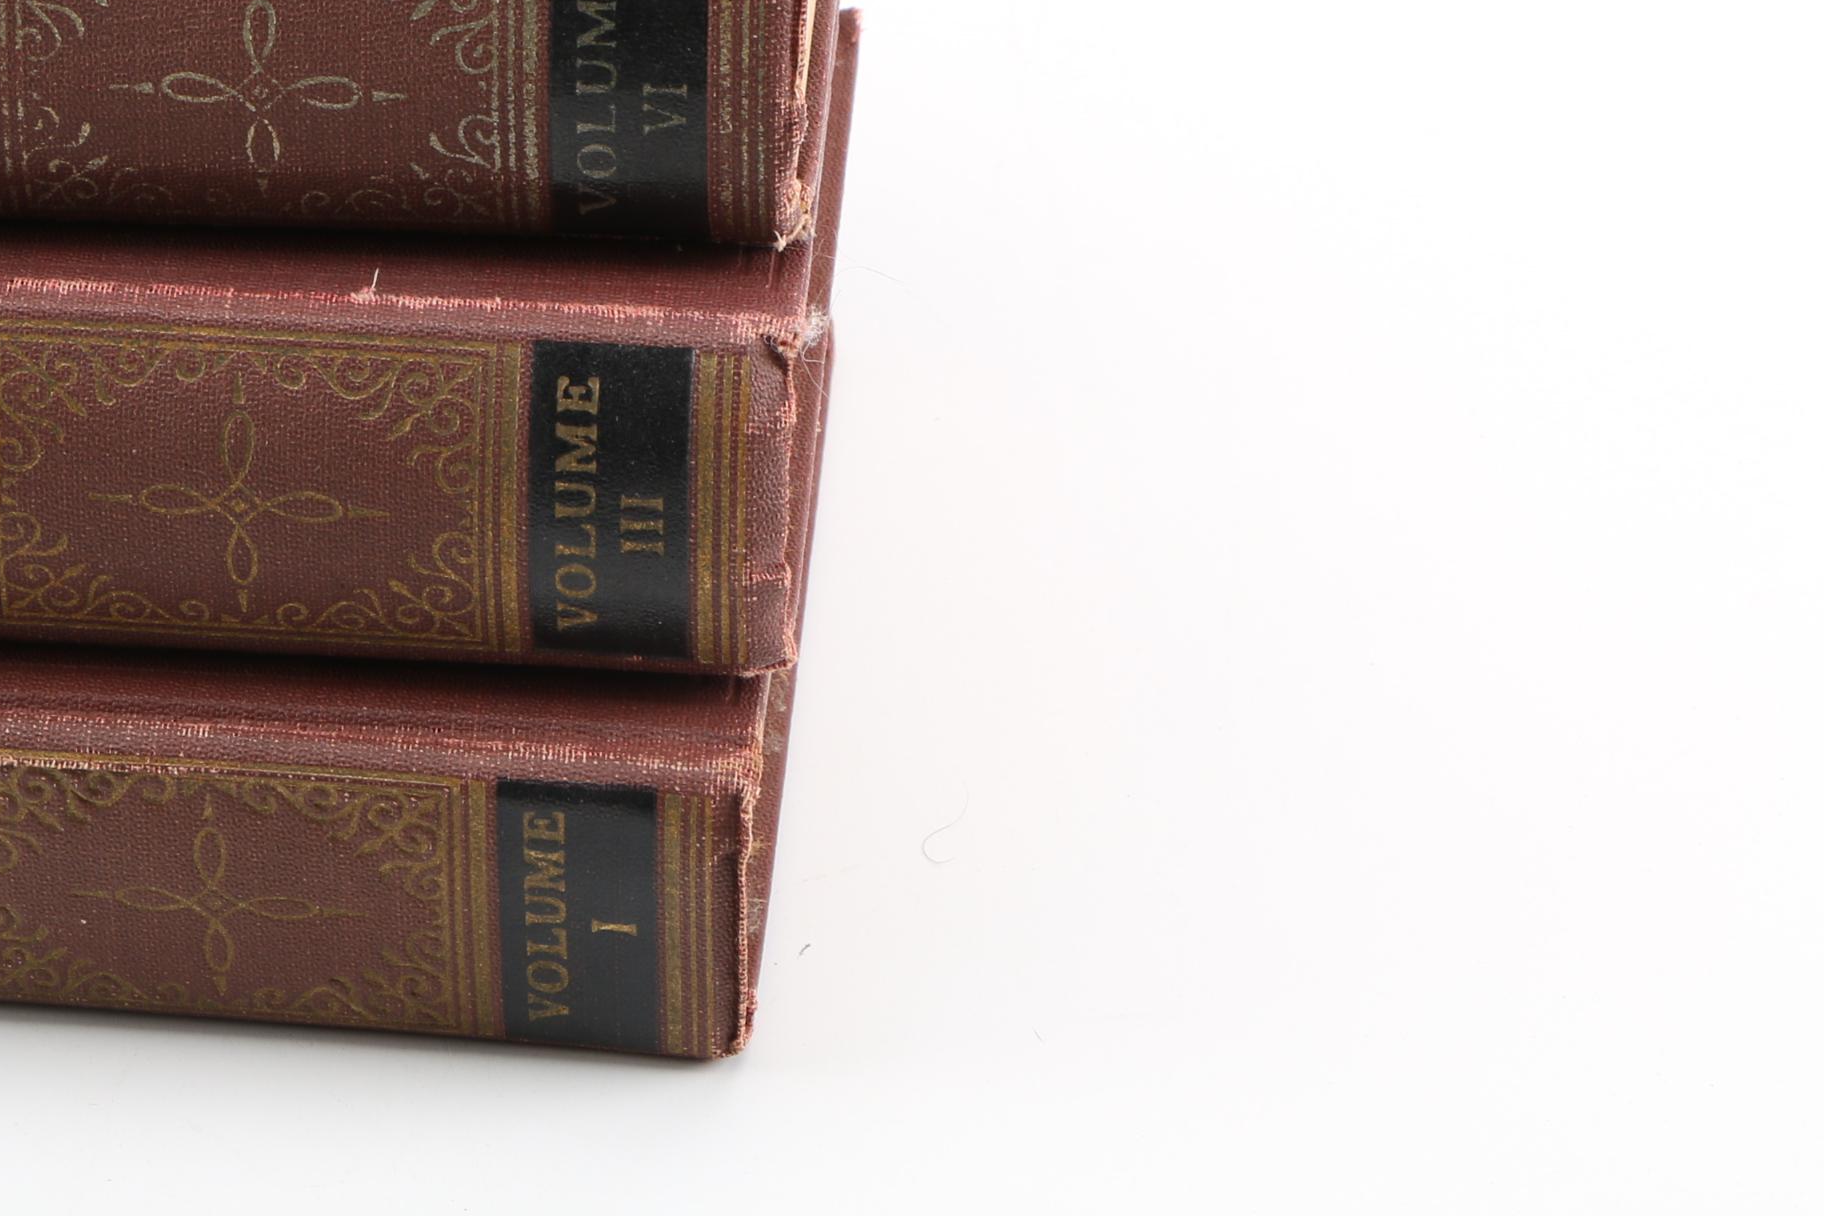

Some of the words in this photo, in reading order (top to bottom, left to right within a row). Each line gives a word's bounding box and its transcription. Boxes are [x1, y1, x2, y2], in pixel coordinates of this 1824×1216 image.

[642, 83, 688, 135] VI
[554, 375, 600, 632] VOLUME
[619, 495, 665, 557] III
[522, 811, 570, 1023] VOLUME
[591, 918, 638, 937] I
